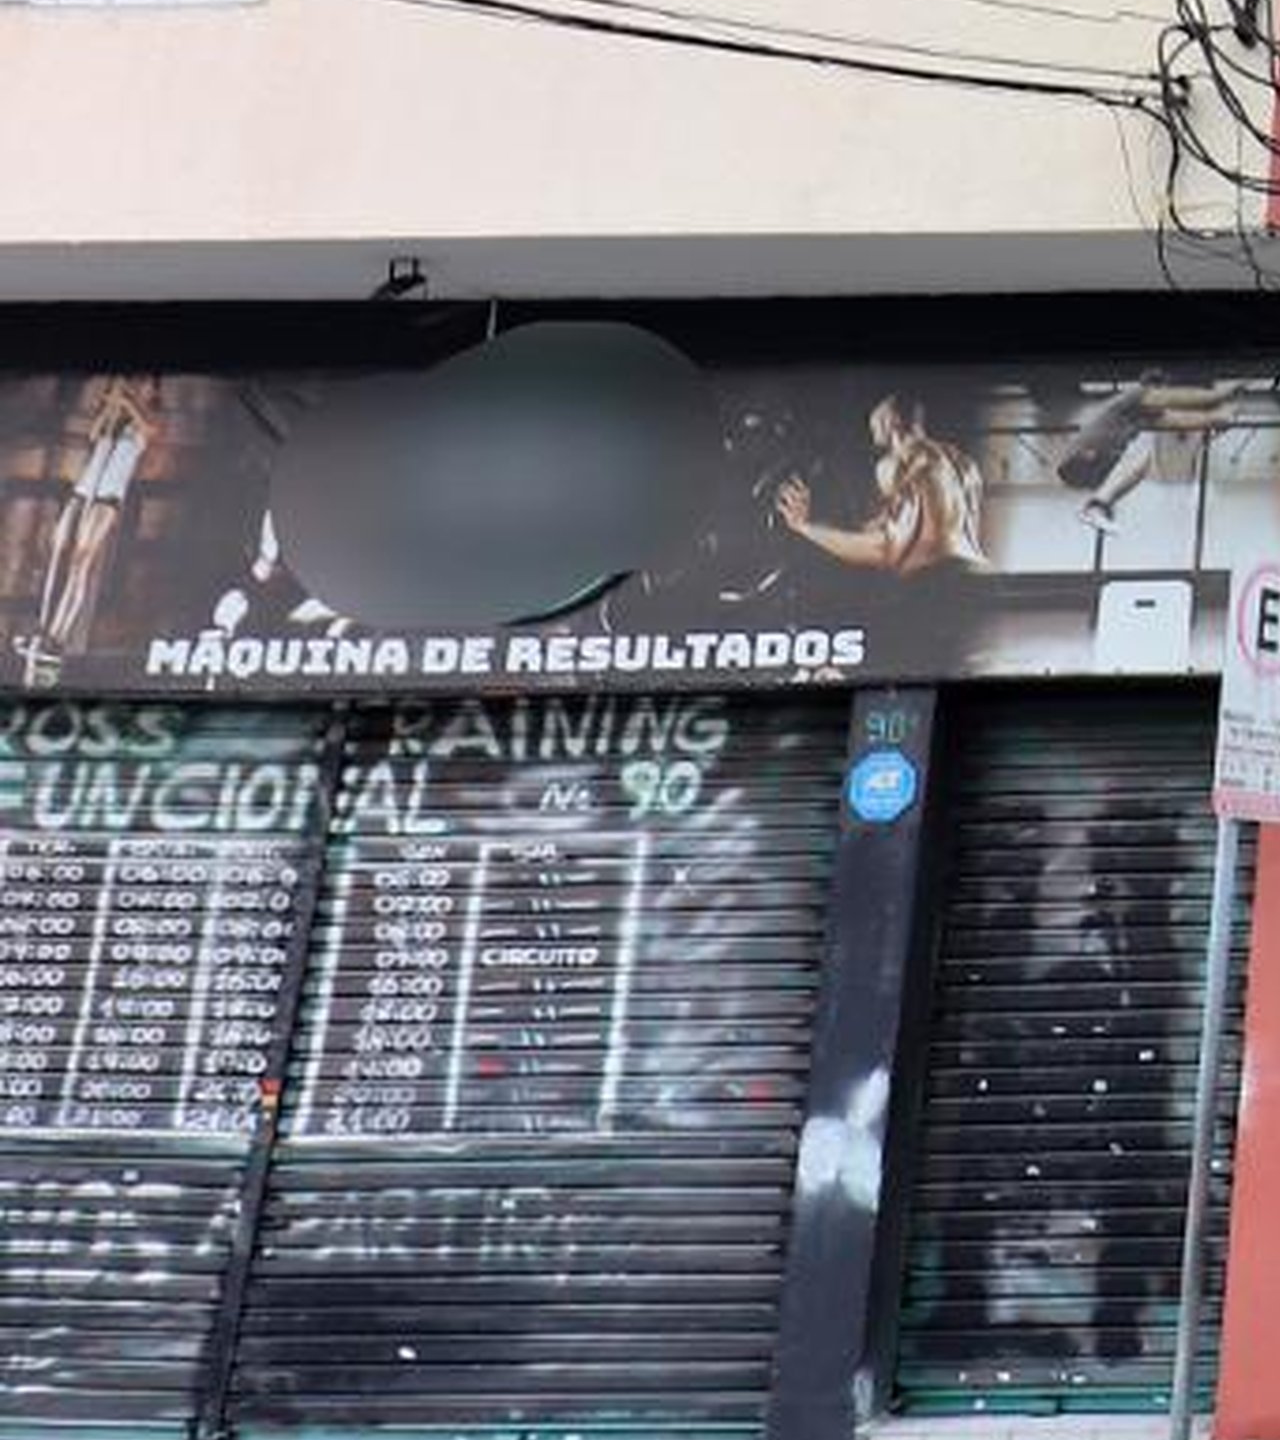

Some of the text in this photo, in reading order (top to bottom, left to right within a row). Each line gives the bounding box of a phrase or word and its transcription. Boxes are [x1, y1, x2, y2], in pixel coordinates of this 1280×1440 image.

[147, 630, 865, 676] MÁQUINA DE RESULTADOS
